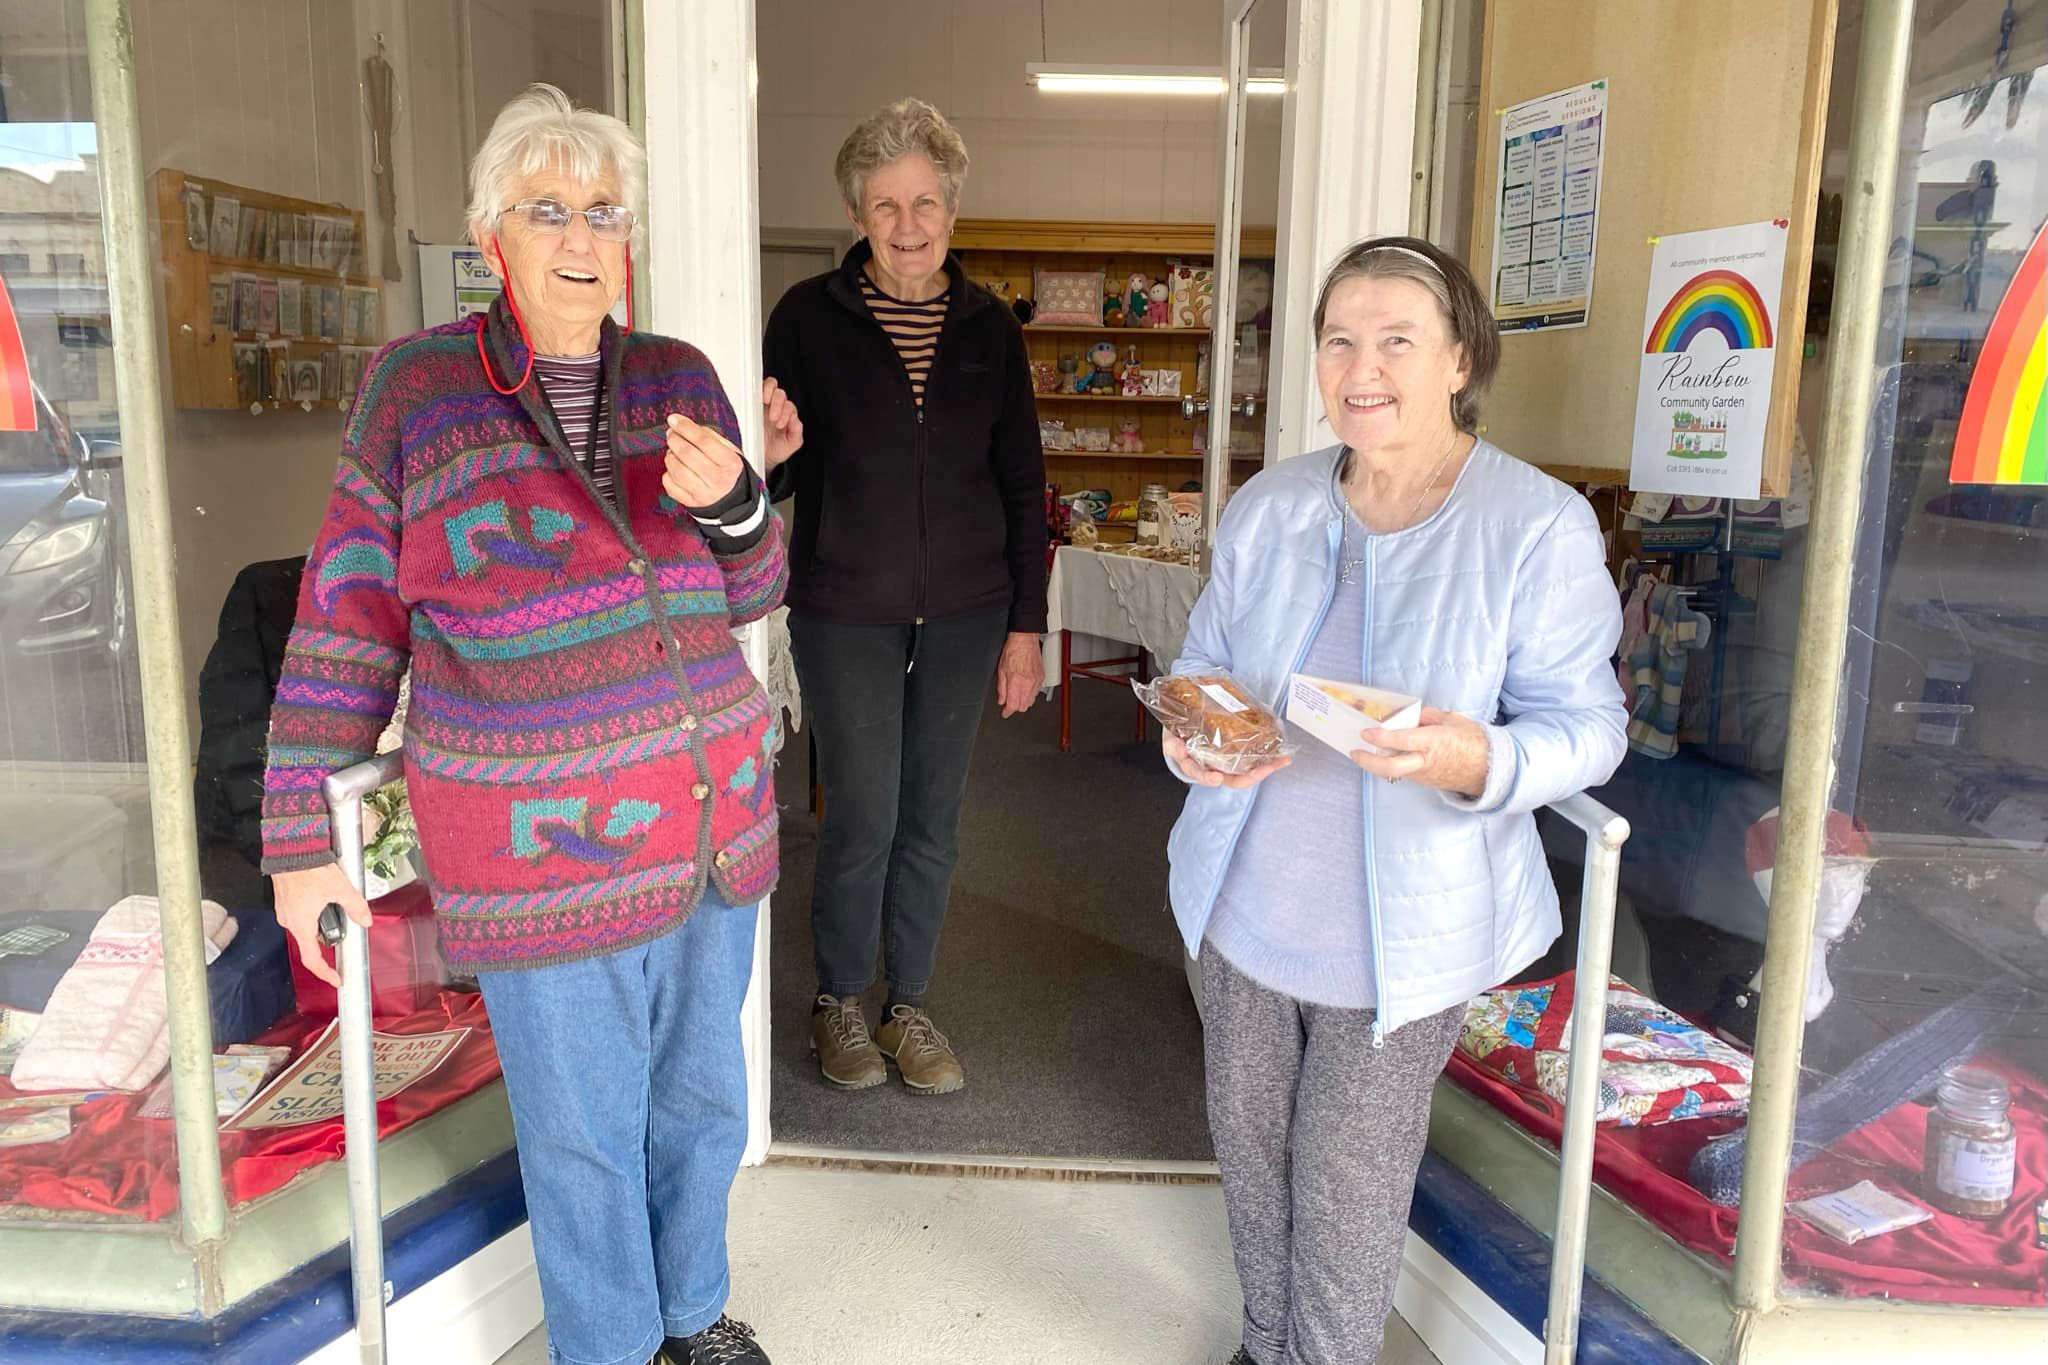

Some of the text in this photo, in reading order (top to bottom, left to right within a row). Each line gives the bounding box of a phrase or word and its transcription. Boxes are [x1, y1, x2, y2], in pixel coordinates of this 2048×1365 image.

[1566, 95, 1597, 108] REGULAR
[1562, 106, 1596, 120] SESSIONS
[1678, 257, 1708, 267] community
[1709, 255, 1736, 264] members
[1657, 354, 1752, 392] Rainbow
[1660, 395, 1745, 410] Community Garden
[402, 1039, 442, 1050] AND
[396, 1050, 437, 1061] OUT
[302, 1072, 409, 1086] CAES
[270, 1097, 344, 1111] SLIC
[267, 1108, 344, 1122] INSID
